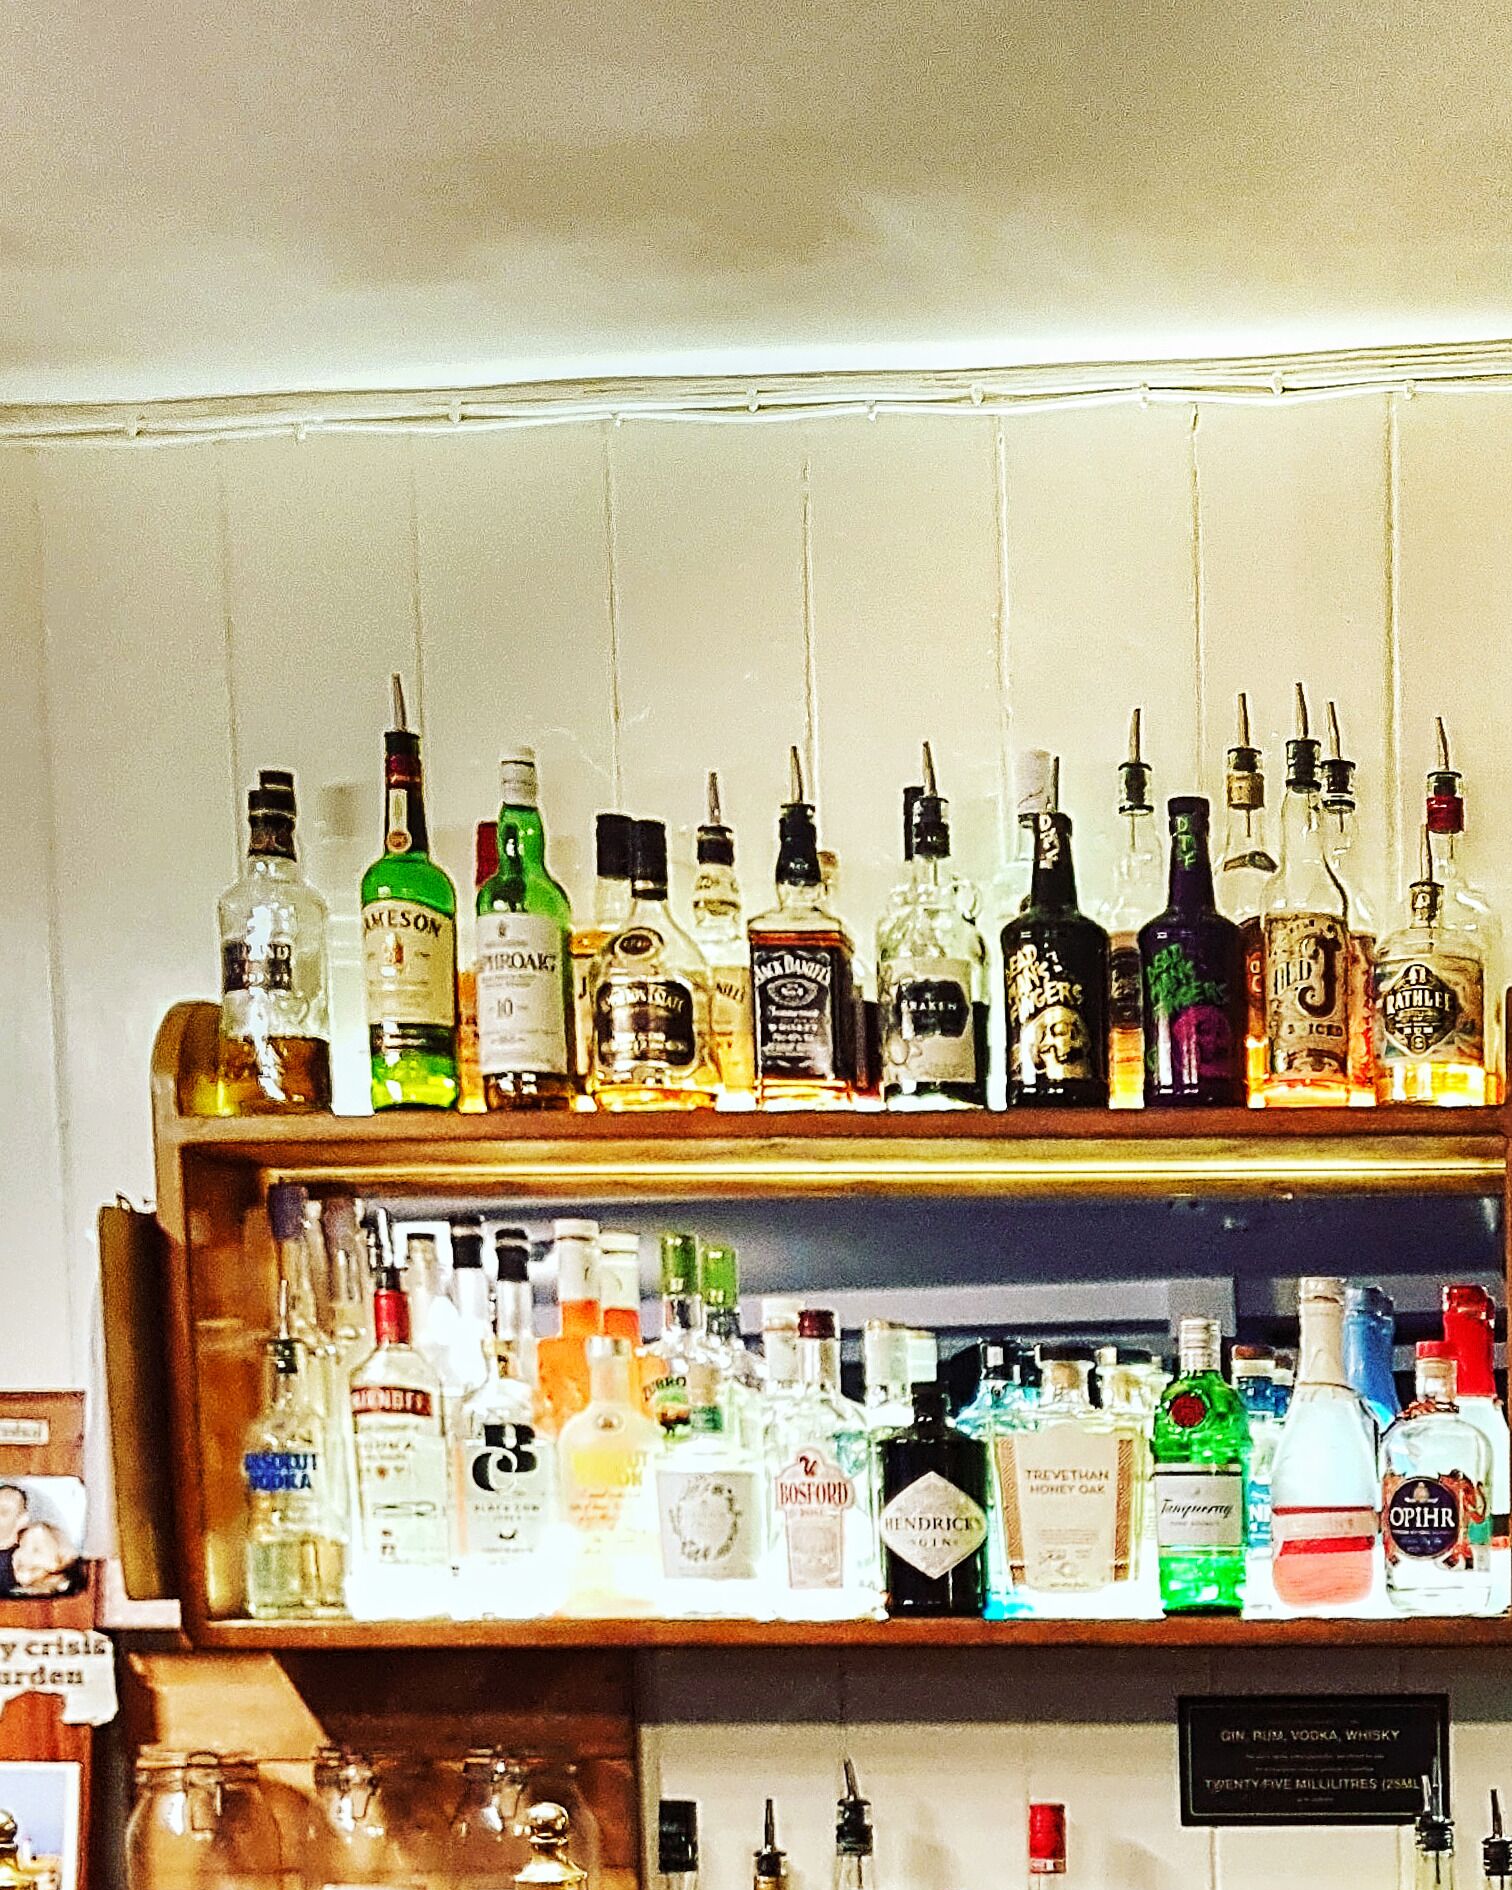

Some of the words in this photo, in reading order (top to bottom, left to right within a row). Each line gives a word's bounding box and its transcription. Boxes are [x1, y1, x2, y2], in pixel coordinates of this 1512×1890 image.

[753, 959, 785, 987] JACK
[1025, 1469, 1110, 1481] TREVETHAN
[779, 1481, 849, 1505] BOSFORD
[1029, 1484, 1074, 1495] HONEY
[1078, 1484, 1105, 1495] OAK
[1160, 1498, 1234, 1519] Tanqueray
[1389, 1505, 1456, 1528] OPIHR
[1345, 1729, 1400, 1742] WHISKY
[1295, 1778, 1377, 1790] MILLILITRES
[1382, 1778, 1421, 1791] (25ML
